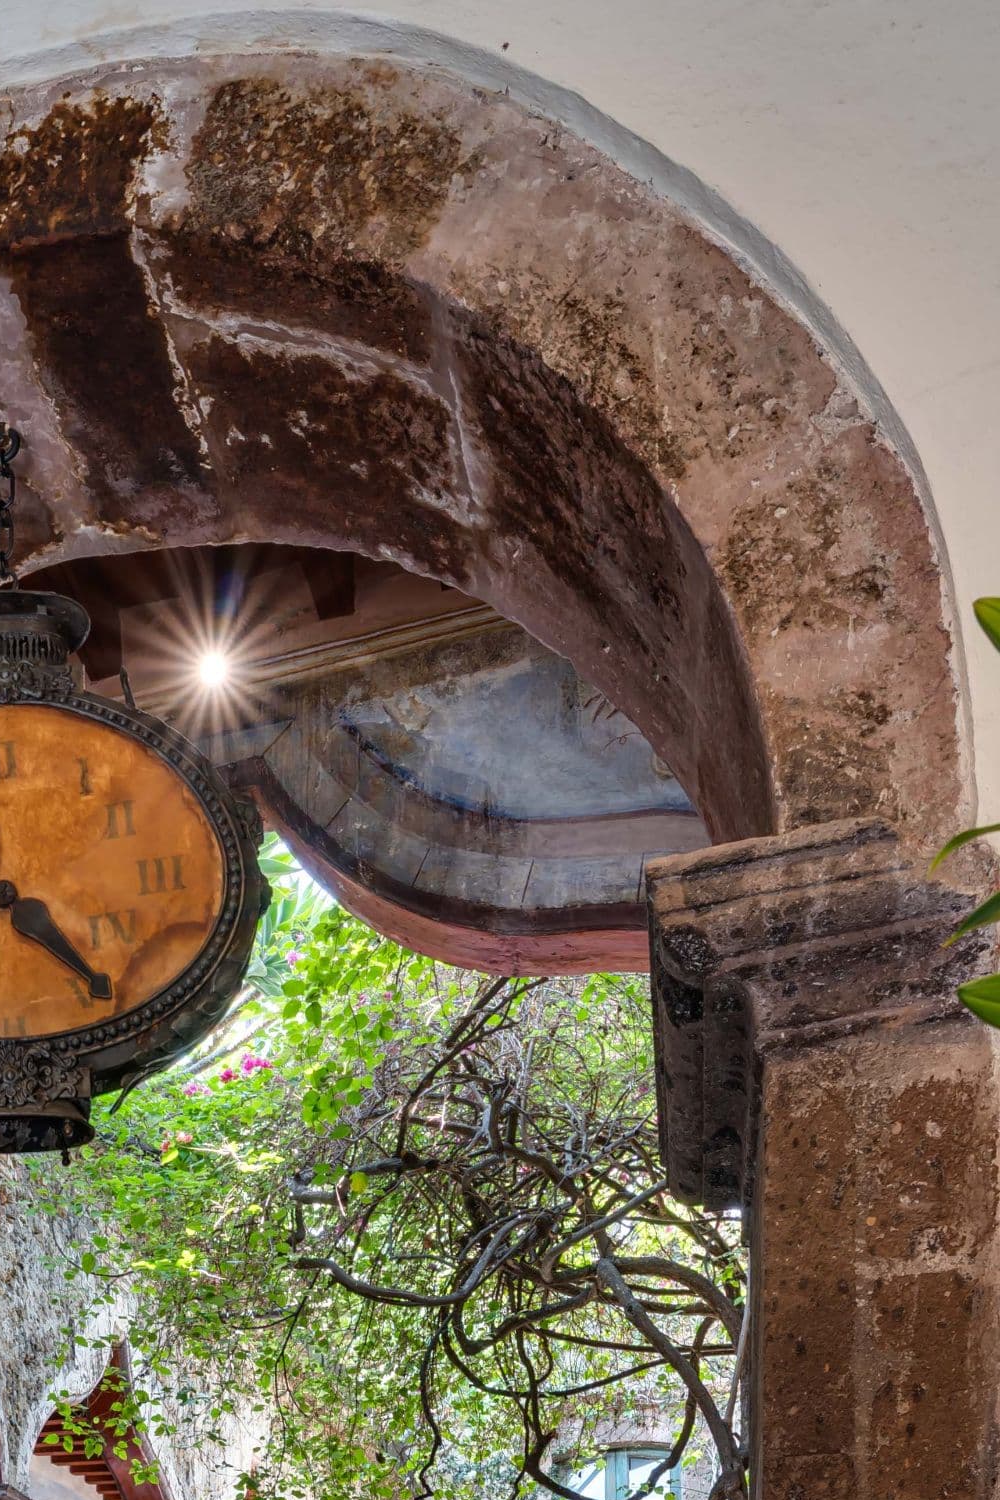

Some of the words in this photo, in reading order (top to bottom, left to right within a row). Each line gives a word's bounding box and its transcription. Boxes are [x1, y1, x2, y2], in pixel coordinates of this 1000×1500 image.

[77, 758, 92, 796] I
[104, 800, 136, 840] II
[137, 855, 185, 896] III
[89, 910, 137, 950] IV
